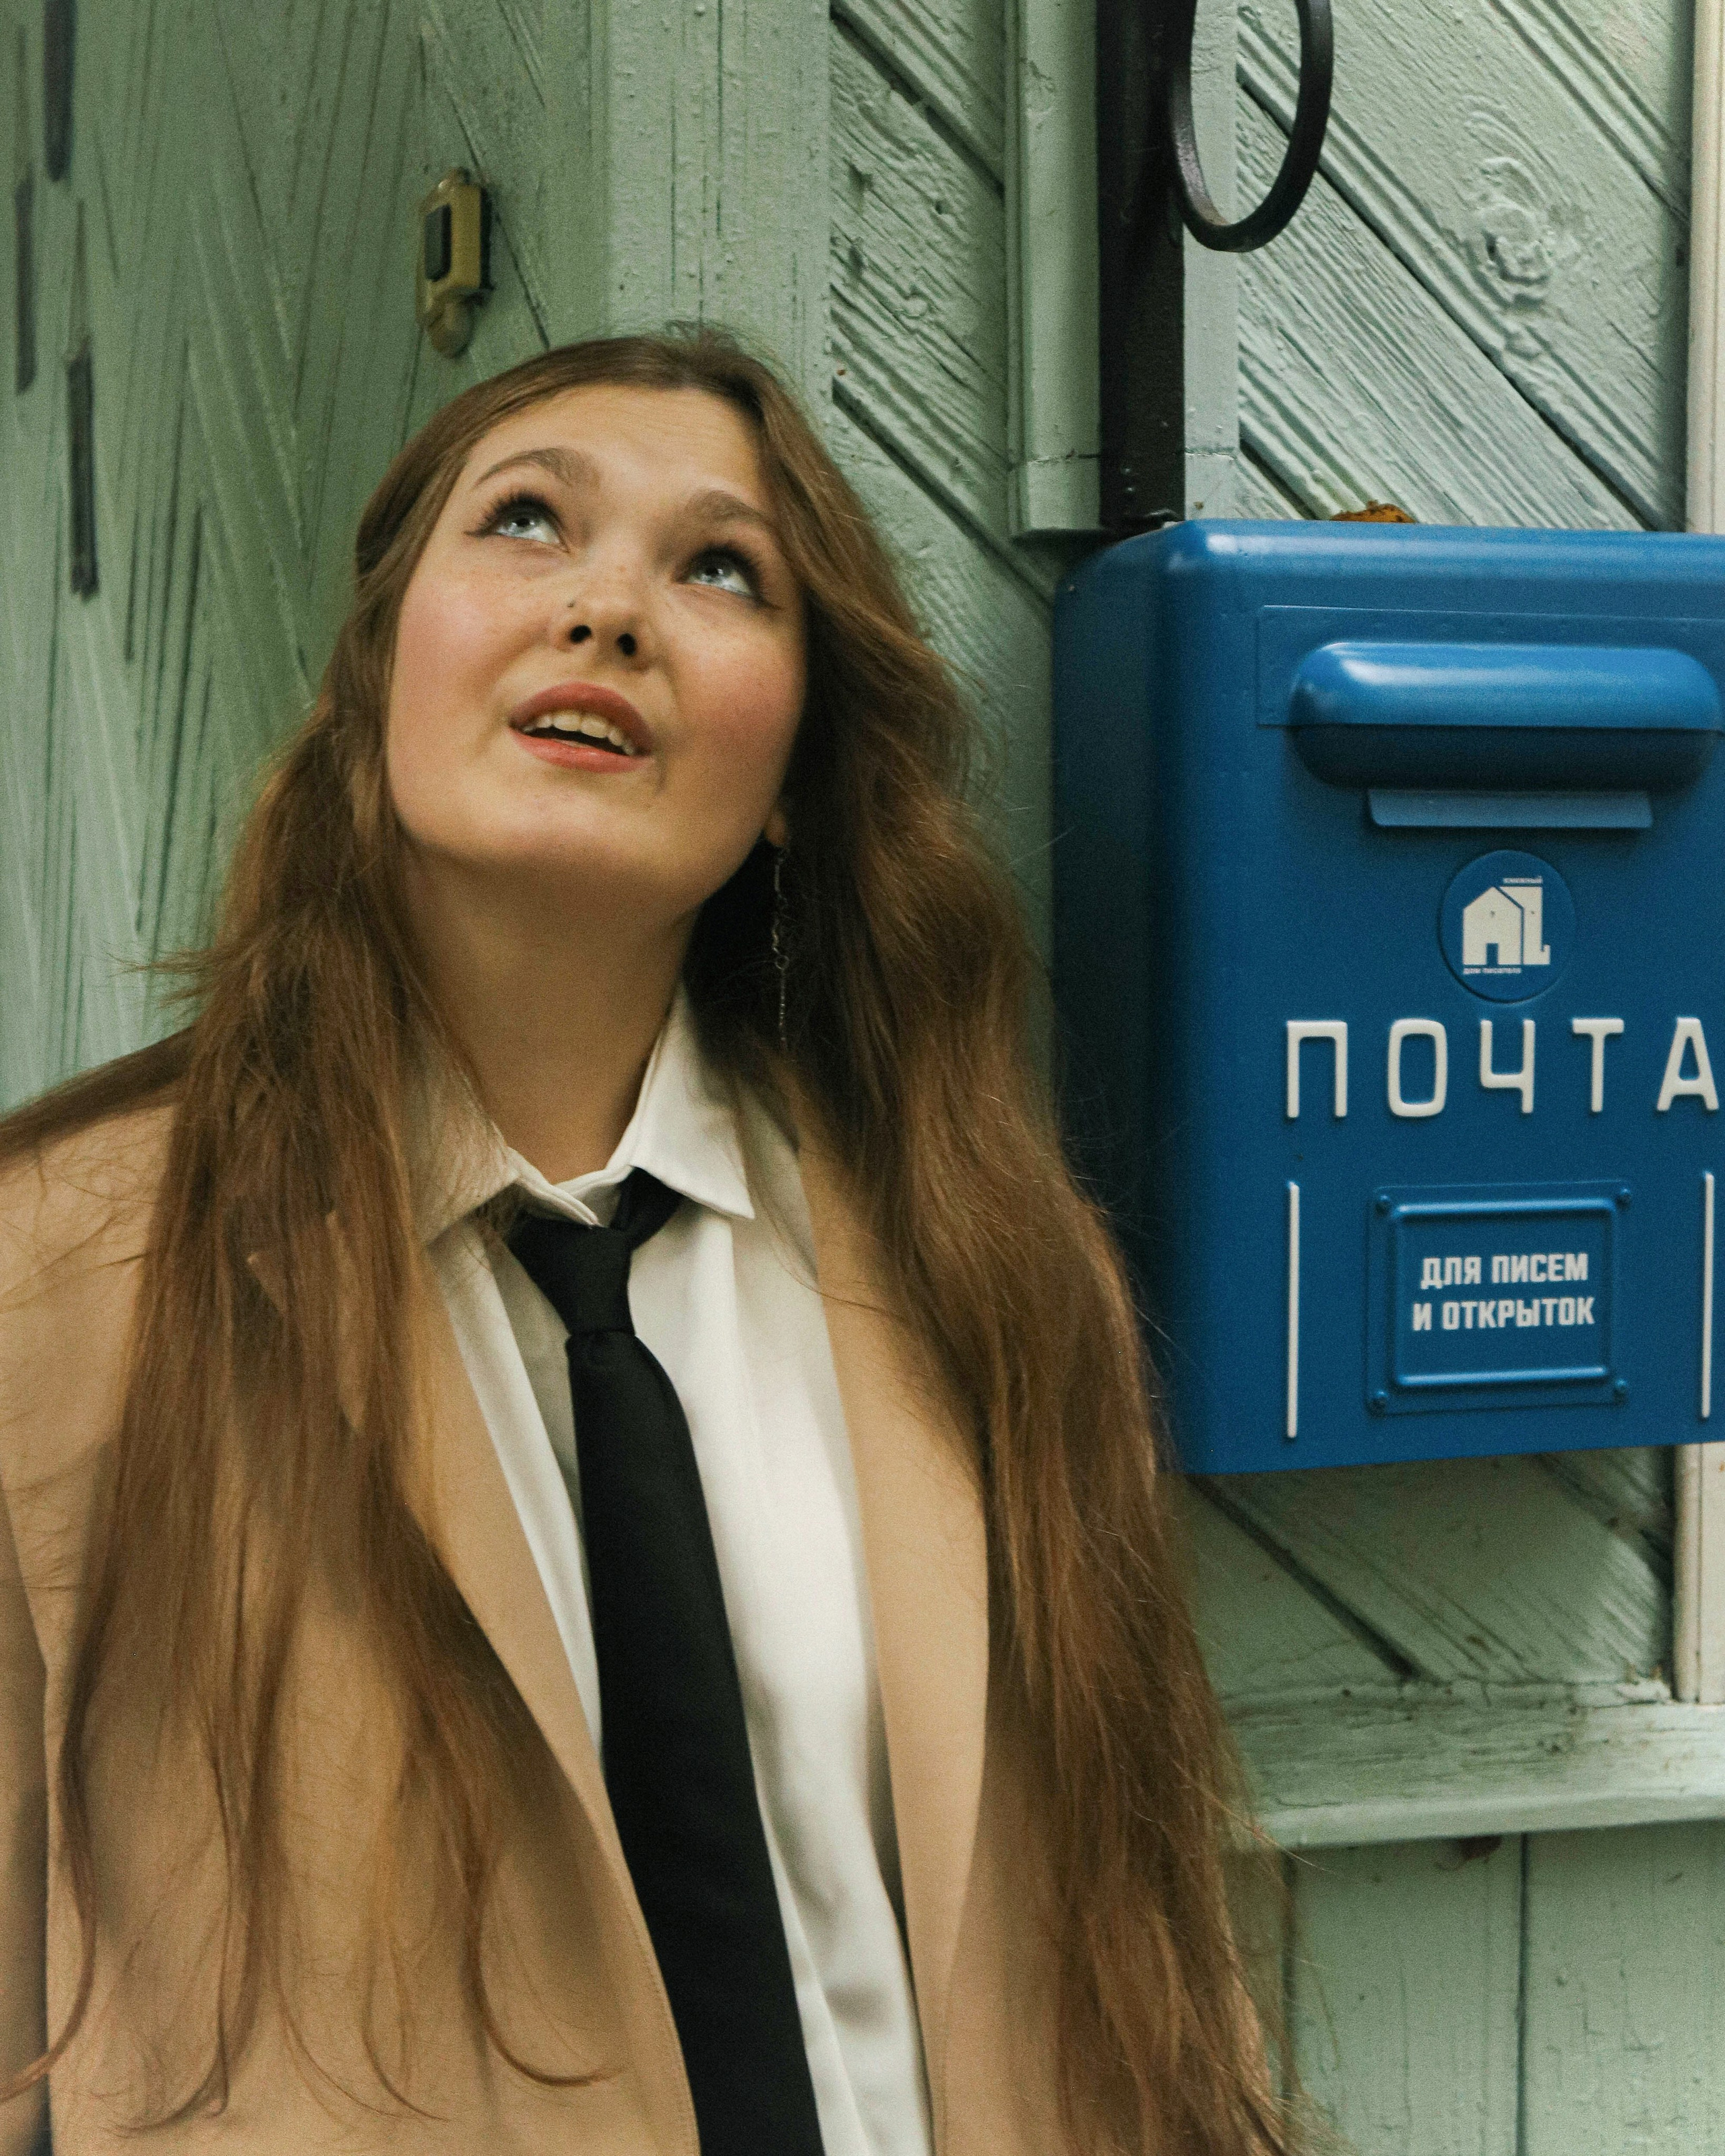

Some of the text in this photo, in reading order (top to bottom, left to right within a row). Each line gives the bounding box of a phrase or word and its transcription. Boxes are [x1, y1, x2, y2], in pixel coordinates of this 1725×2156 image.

[1286, 1017, 1719, 1118] ПОЧТА
[1420, 1253, 1588, 1290] ДЛЯ ПИСЕМ
[1412, 1296, 1594, 1331] И ОТКРЫТОК
